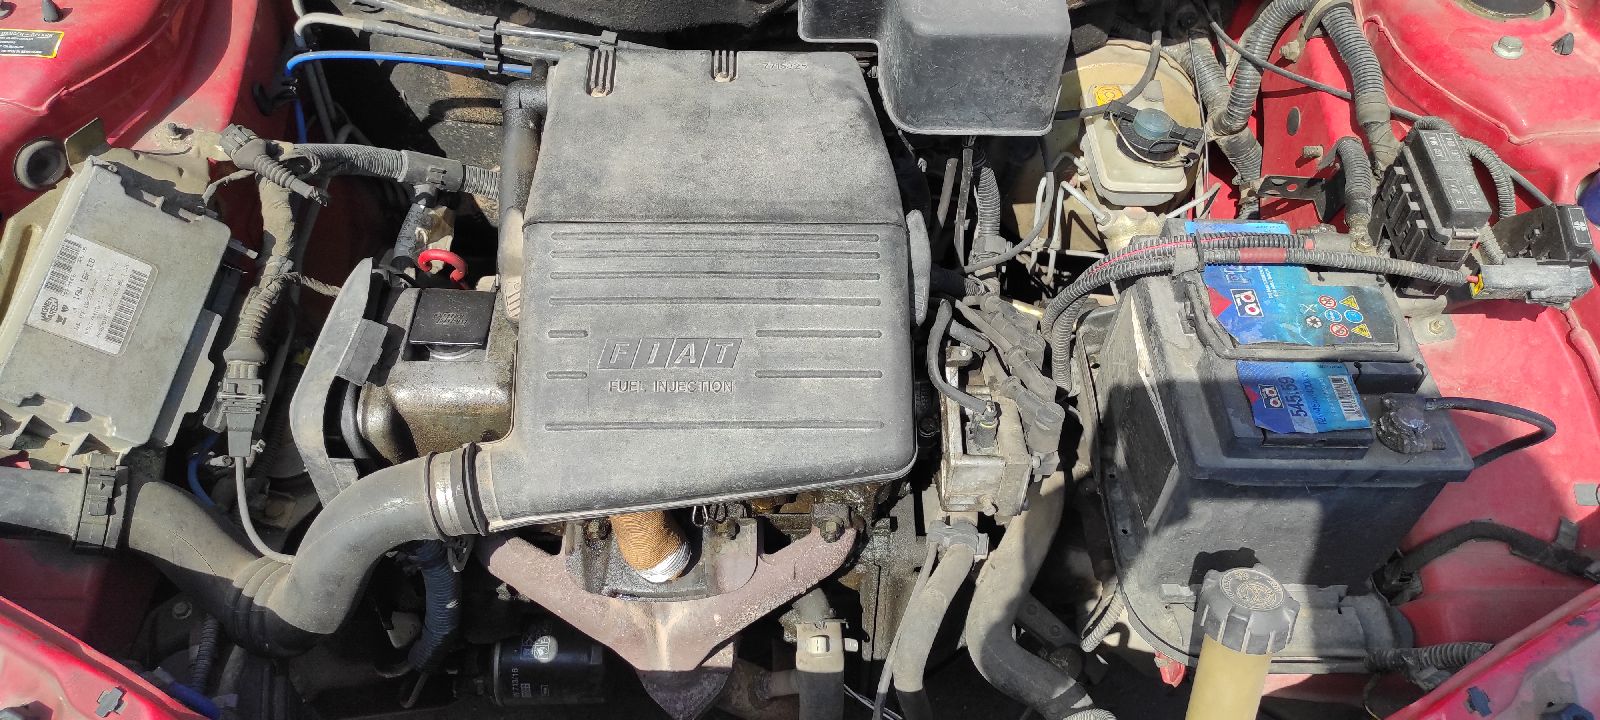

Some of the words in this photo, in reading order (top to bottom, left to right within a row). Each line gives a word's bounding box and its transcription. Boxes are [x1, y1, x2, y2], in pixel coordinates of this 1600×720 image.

[608, 341, 734, 365] FIAT
[608, 380, 648, 393] FUEL
[653, 380, 734, 393] INJECTION
